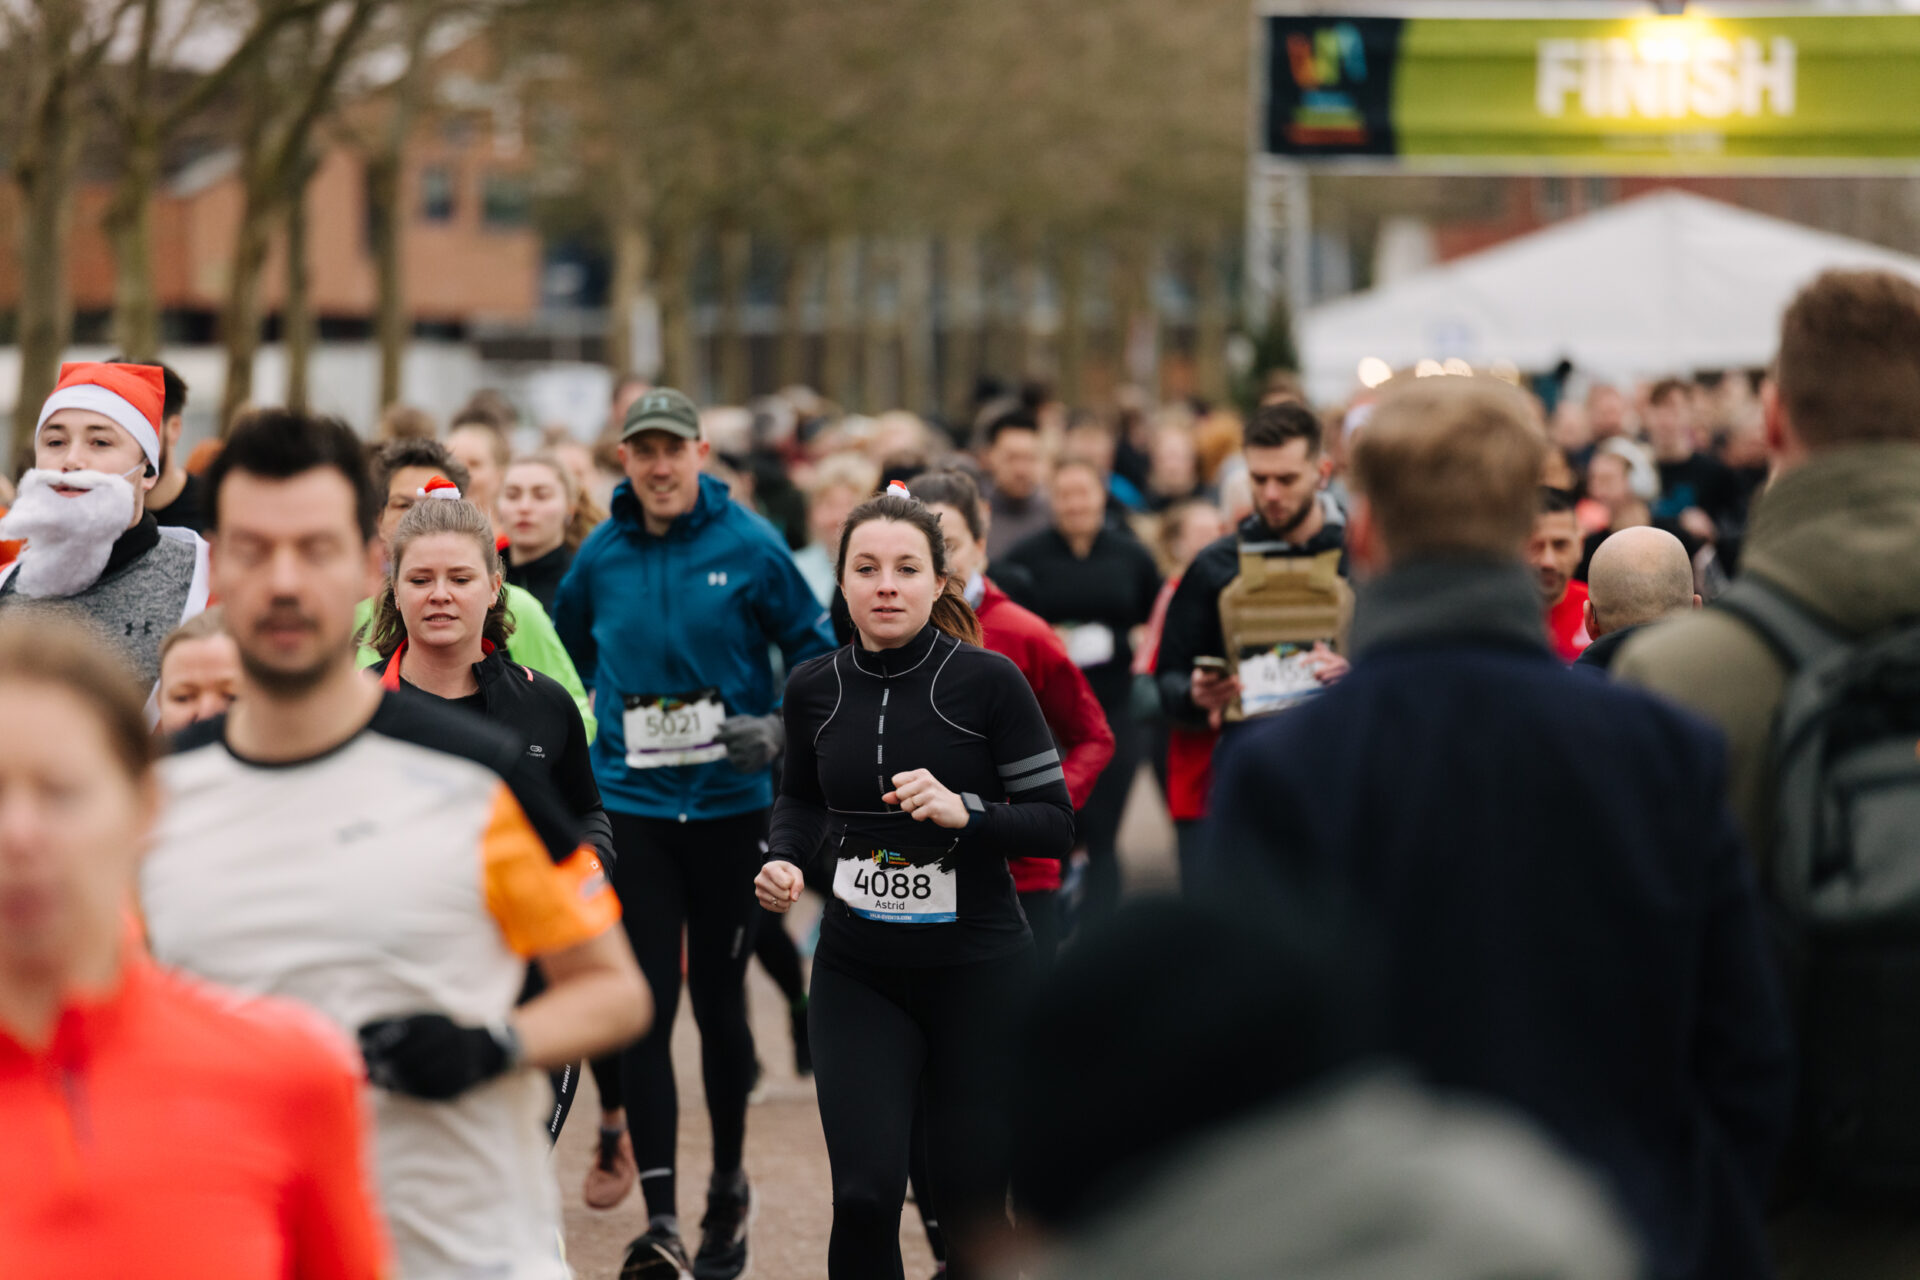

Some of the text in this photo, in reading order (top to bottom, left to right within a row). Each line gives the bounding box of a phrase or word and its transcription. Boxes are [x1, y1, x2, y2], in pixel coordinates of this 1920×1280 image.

[1536, 37, 1796, 118] FINISH
[645, 712, 700, 737] 5021
[854, 868, 931, 900] 4088
[875, 899, 905, 910] Astrid
